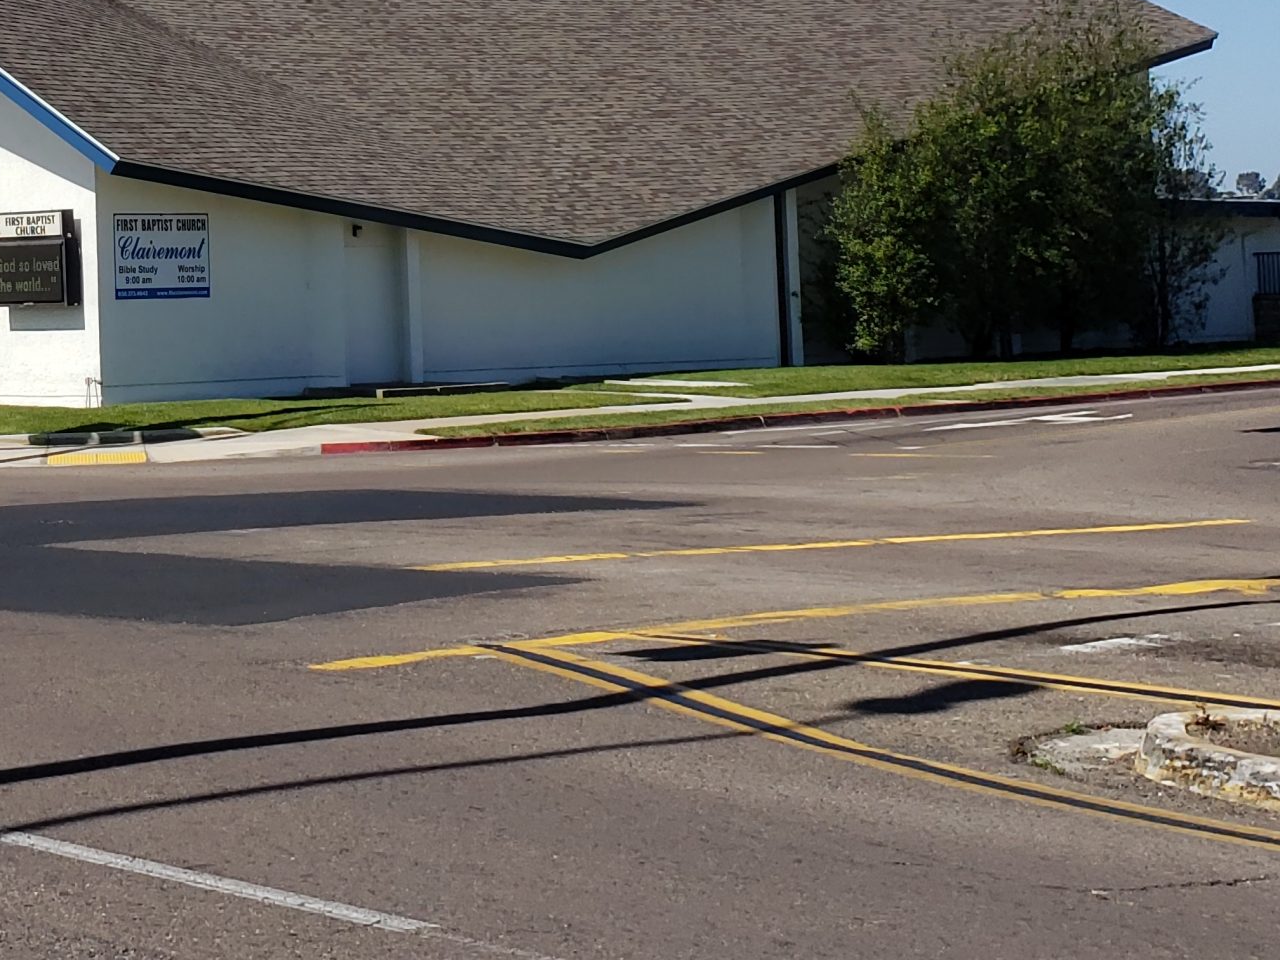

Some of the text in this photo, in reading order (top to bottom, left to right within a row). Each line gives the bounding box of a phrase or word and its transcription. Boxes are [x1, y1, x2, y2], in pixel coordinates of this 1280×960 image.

[5, 214, 56, 226] FIRST BAPTIST
[116, 218, 206, 232] FIRST BAPTIST CHURCH
[15, 225, 46, 236] CHURCH
[118, 235, 206, 260] Clairemont
[18, 261, 30, 272] so
[32, 256, 60, 272] loved
[177, 264, 205, 274] Worship
[119, 265, 158, 275] Bible Study
[125, 276, 140, 284] 9:00
[177, 275, 194, 283] 10:00
